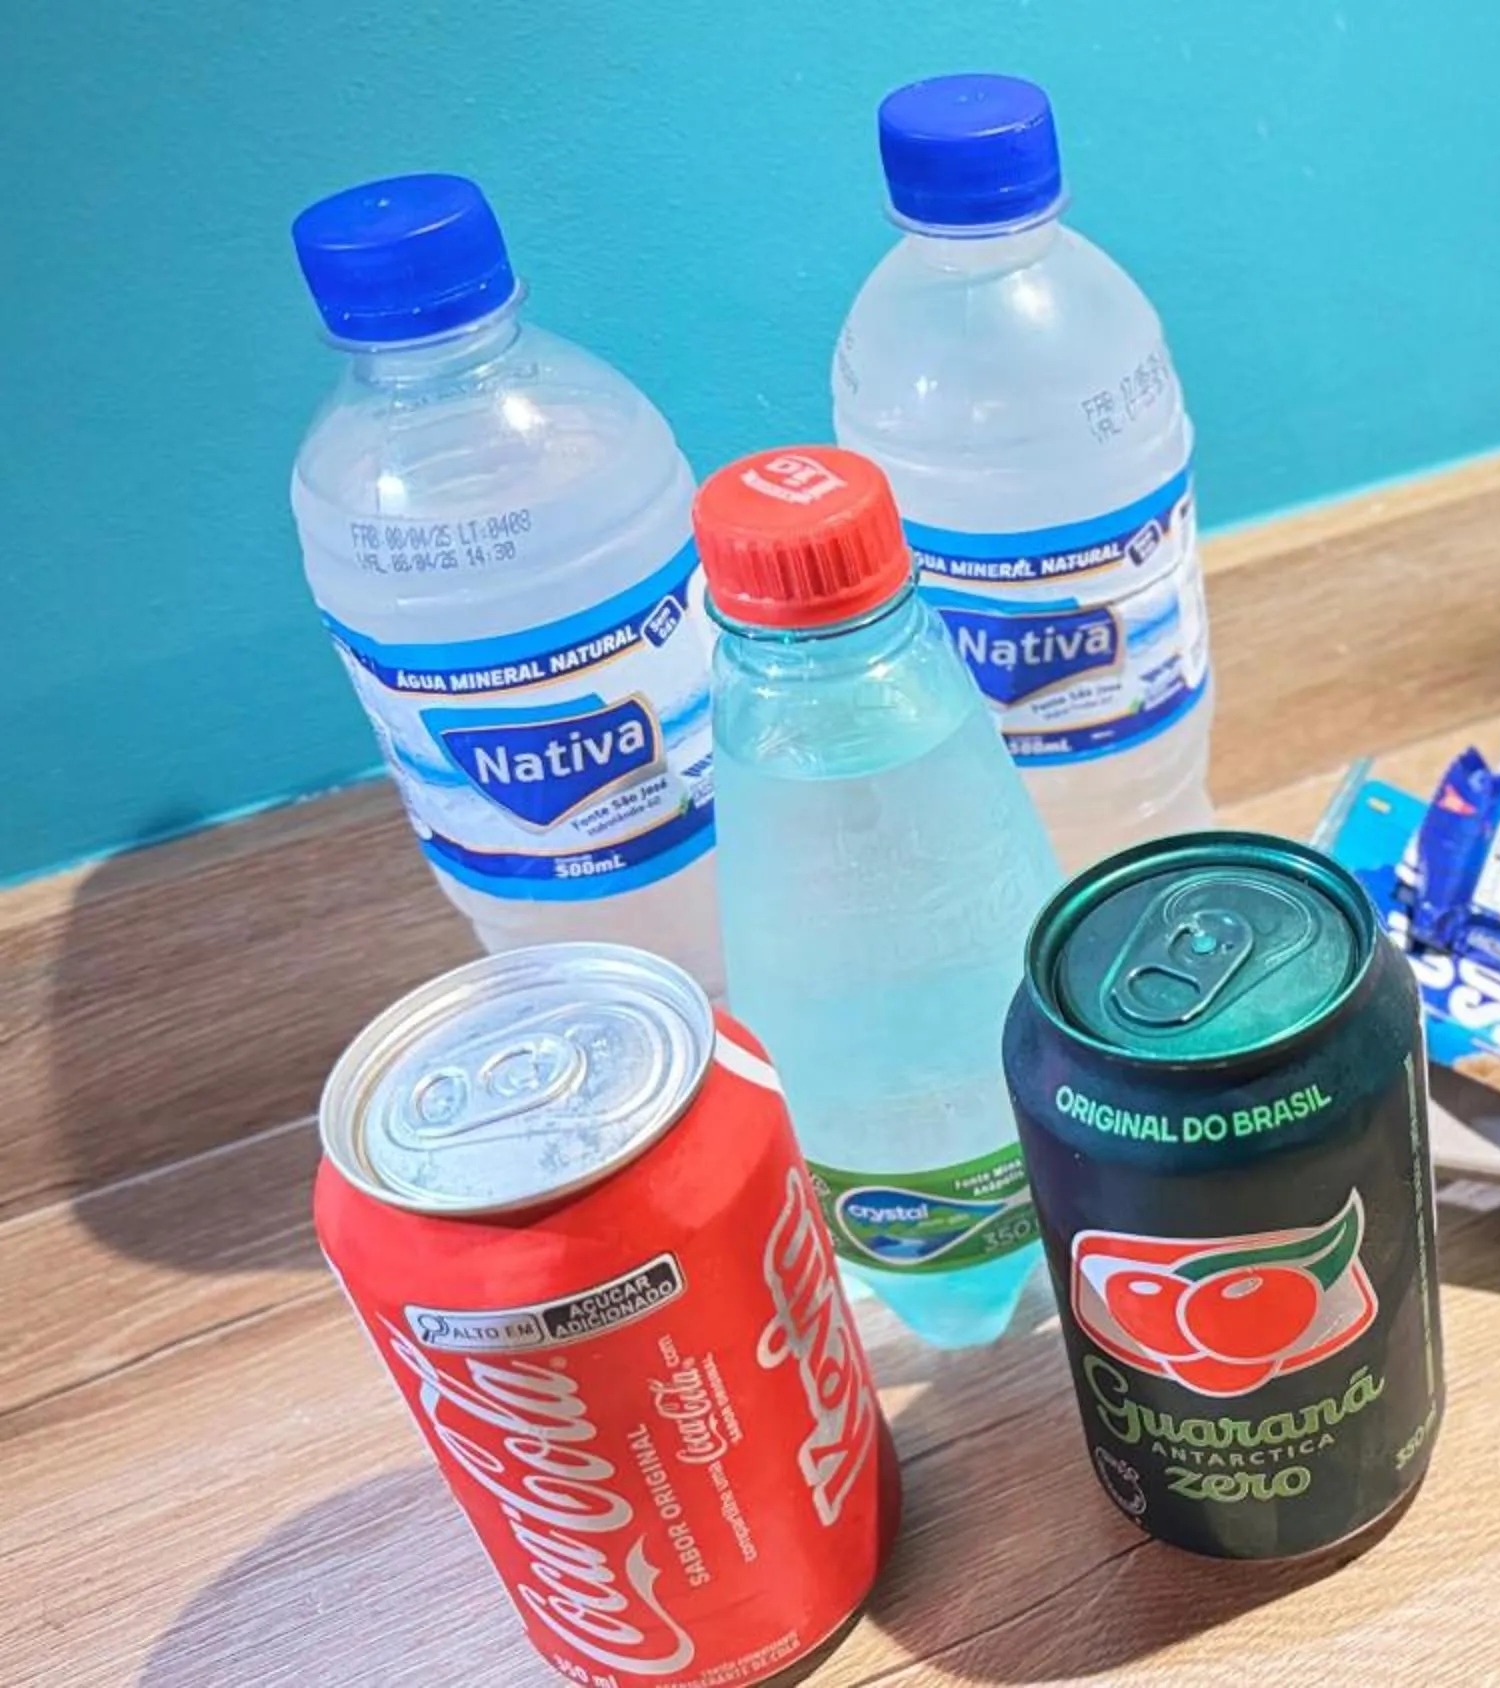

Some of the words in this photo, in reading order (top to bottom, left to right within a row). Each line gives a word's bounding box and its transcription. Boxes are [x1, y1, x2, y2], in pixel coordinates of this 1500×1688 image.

[914, 550, 945, 572] GUA
[949, 557, 1036, 578] MINERAL
[1041, 543, 1122, 574] NATURAL
[396, 670, 447, 692] ÁGUA
[449, 660, 545, 692] MINERAL
[549, 625, 639, 674] NATURAL
[957, 624, 1112, 668] Nativa
[472, 719, 646, 785] Nativa
[1055, 1085, 1178, 1143] ORIGINAL
[1183, 1113, 1228, 1142] DO
[1232, 1085, 1333, 1138] BRASIL
[848, 1203, 929, 1224] crystal
[453, 1325, 500, 1340] ALTO
[505, 1321, 535, 1338] EM
[555, 1280, 675, 1338] ADICIONADO
[1082, 1355, 1386, 1448] Guaraná
[627, 1424, 682, 1519] ORIGINAL
[1152, 1432, 1338, 1467] ANTARCTICA
[1166, 1464, 1312, 1504] zero
[668, 1521, 711, 1588] SABOR
